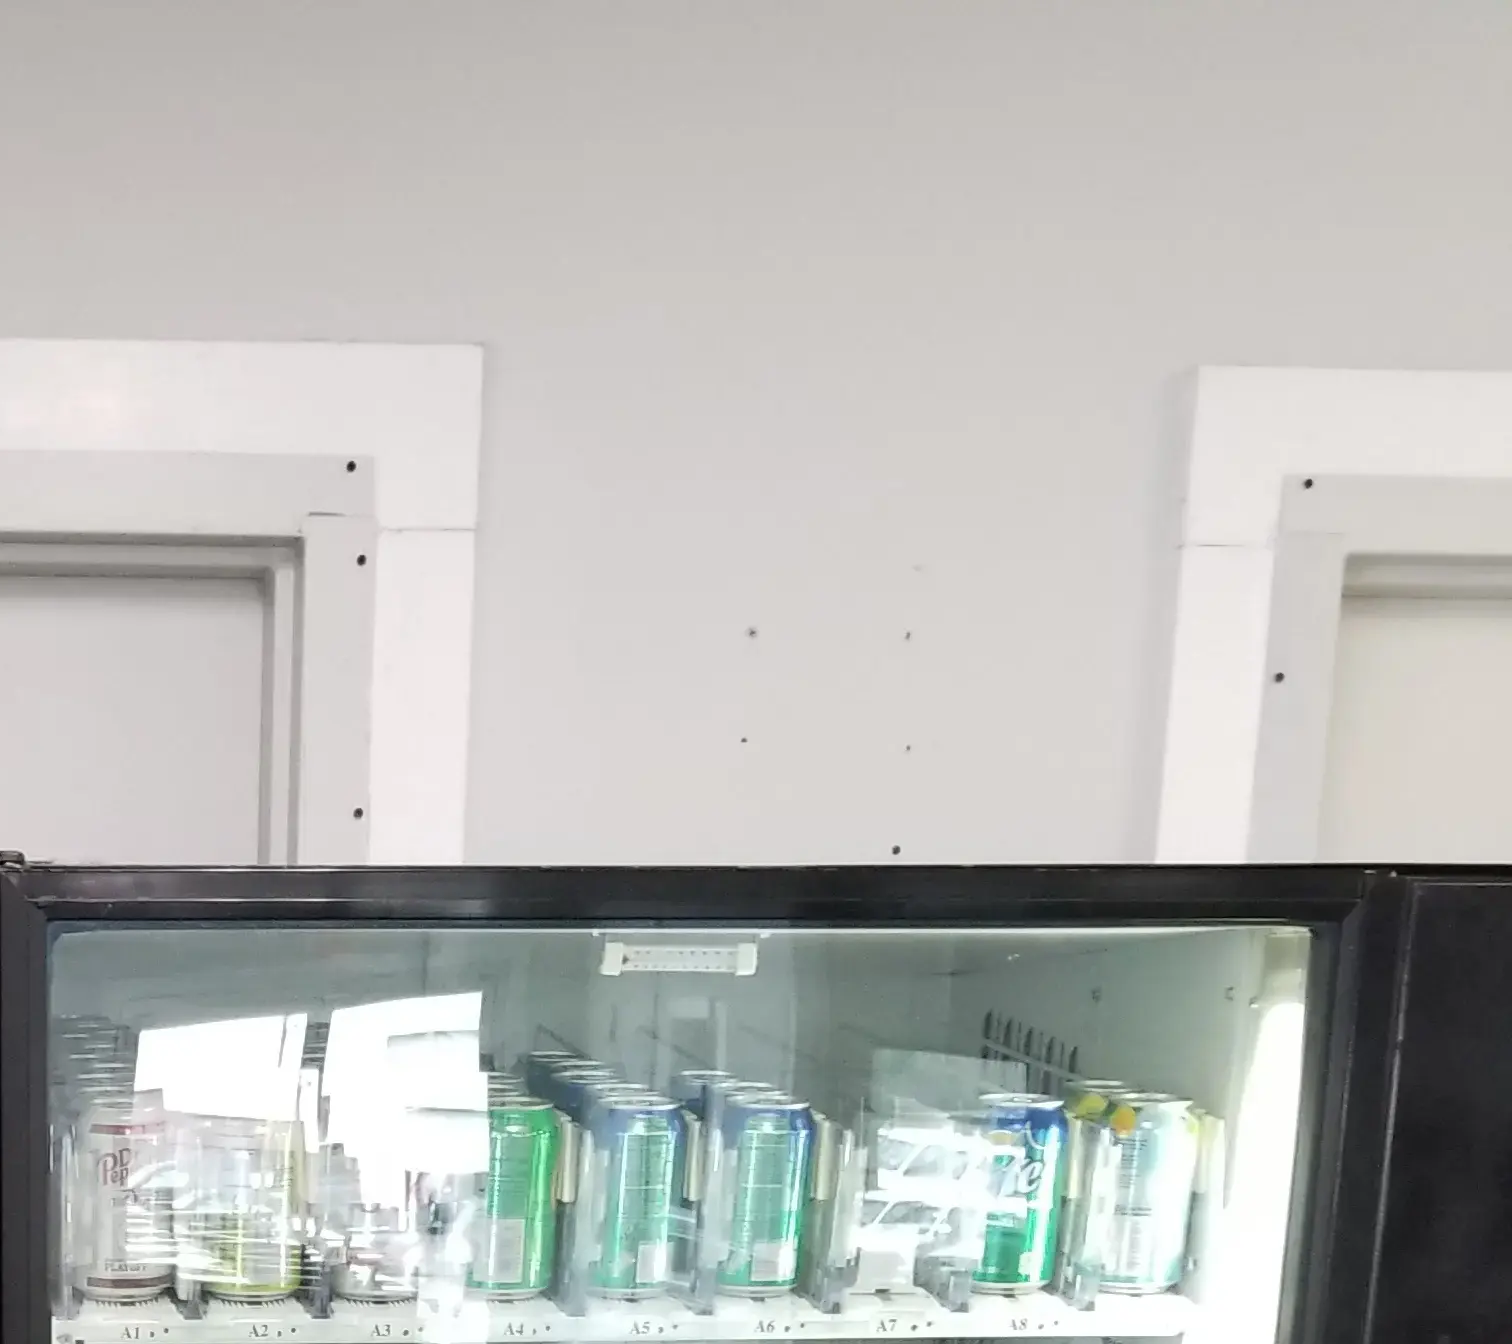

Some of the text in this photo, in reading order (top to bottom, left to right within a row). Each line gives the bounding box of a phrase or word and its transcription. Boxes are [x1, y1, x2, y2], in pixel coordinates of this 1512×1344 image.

[119, 1325, 141, 1340] A1
[248, 1324, 269, 1339] A2
[370, 1323, 392, 1338] A3
[502, 1322, 525, 1337] A4
[628, 1321, 650, 1336] A5
[753, 1320, 776, 1335] A6
[876, 1318, 898, 1333] A7
